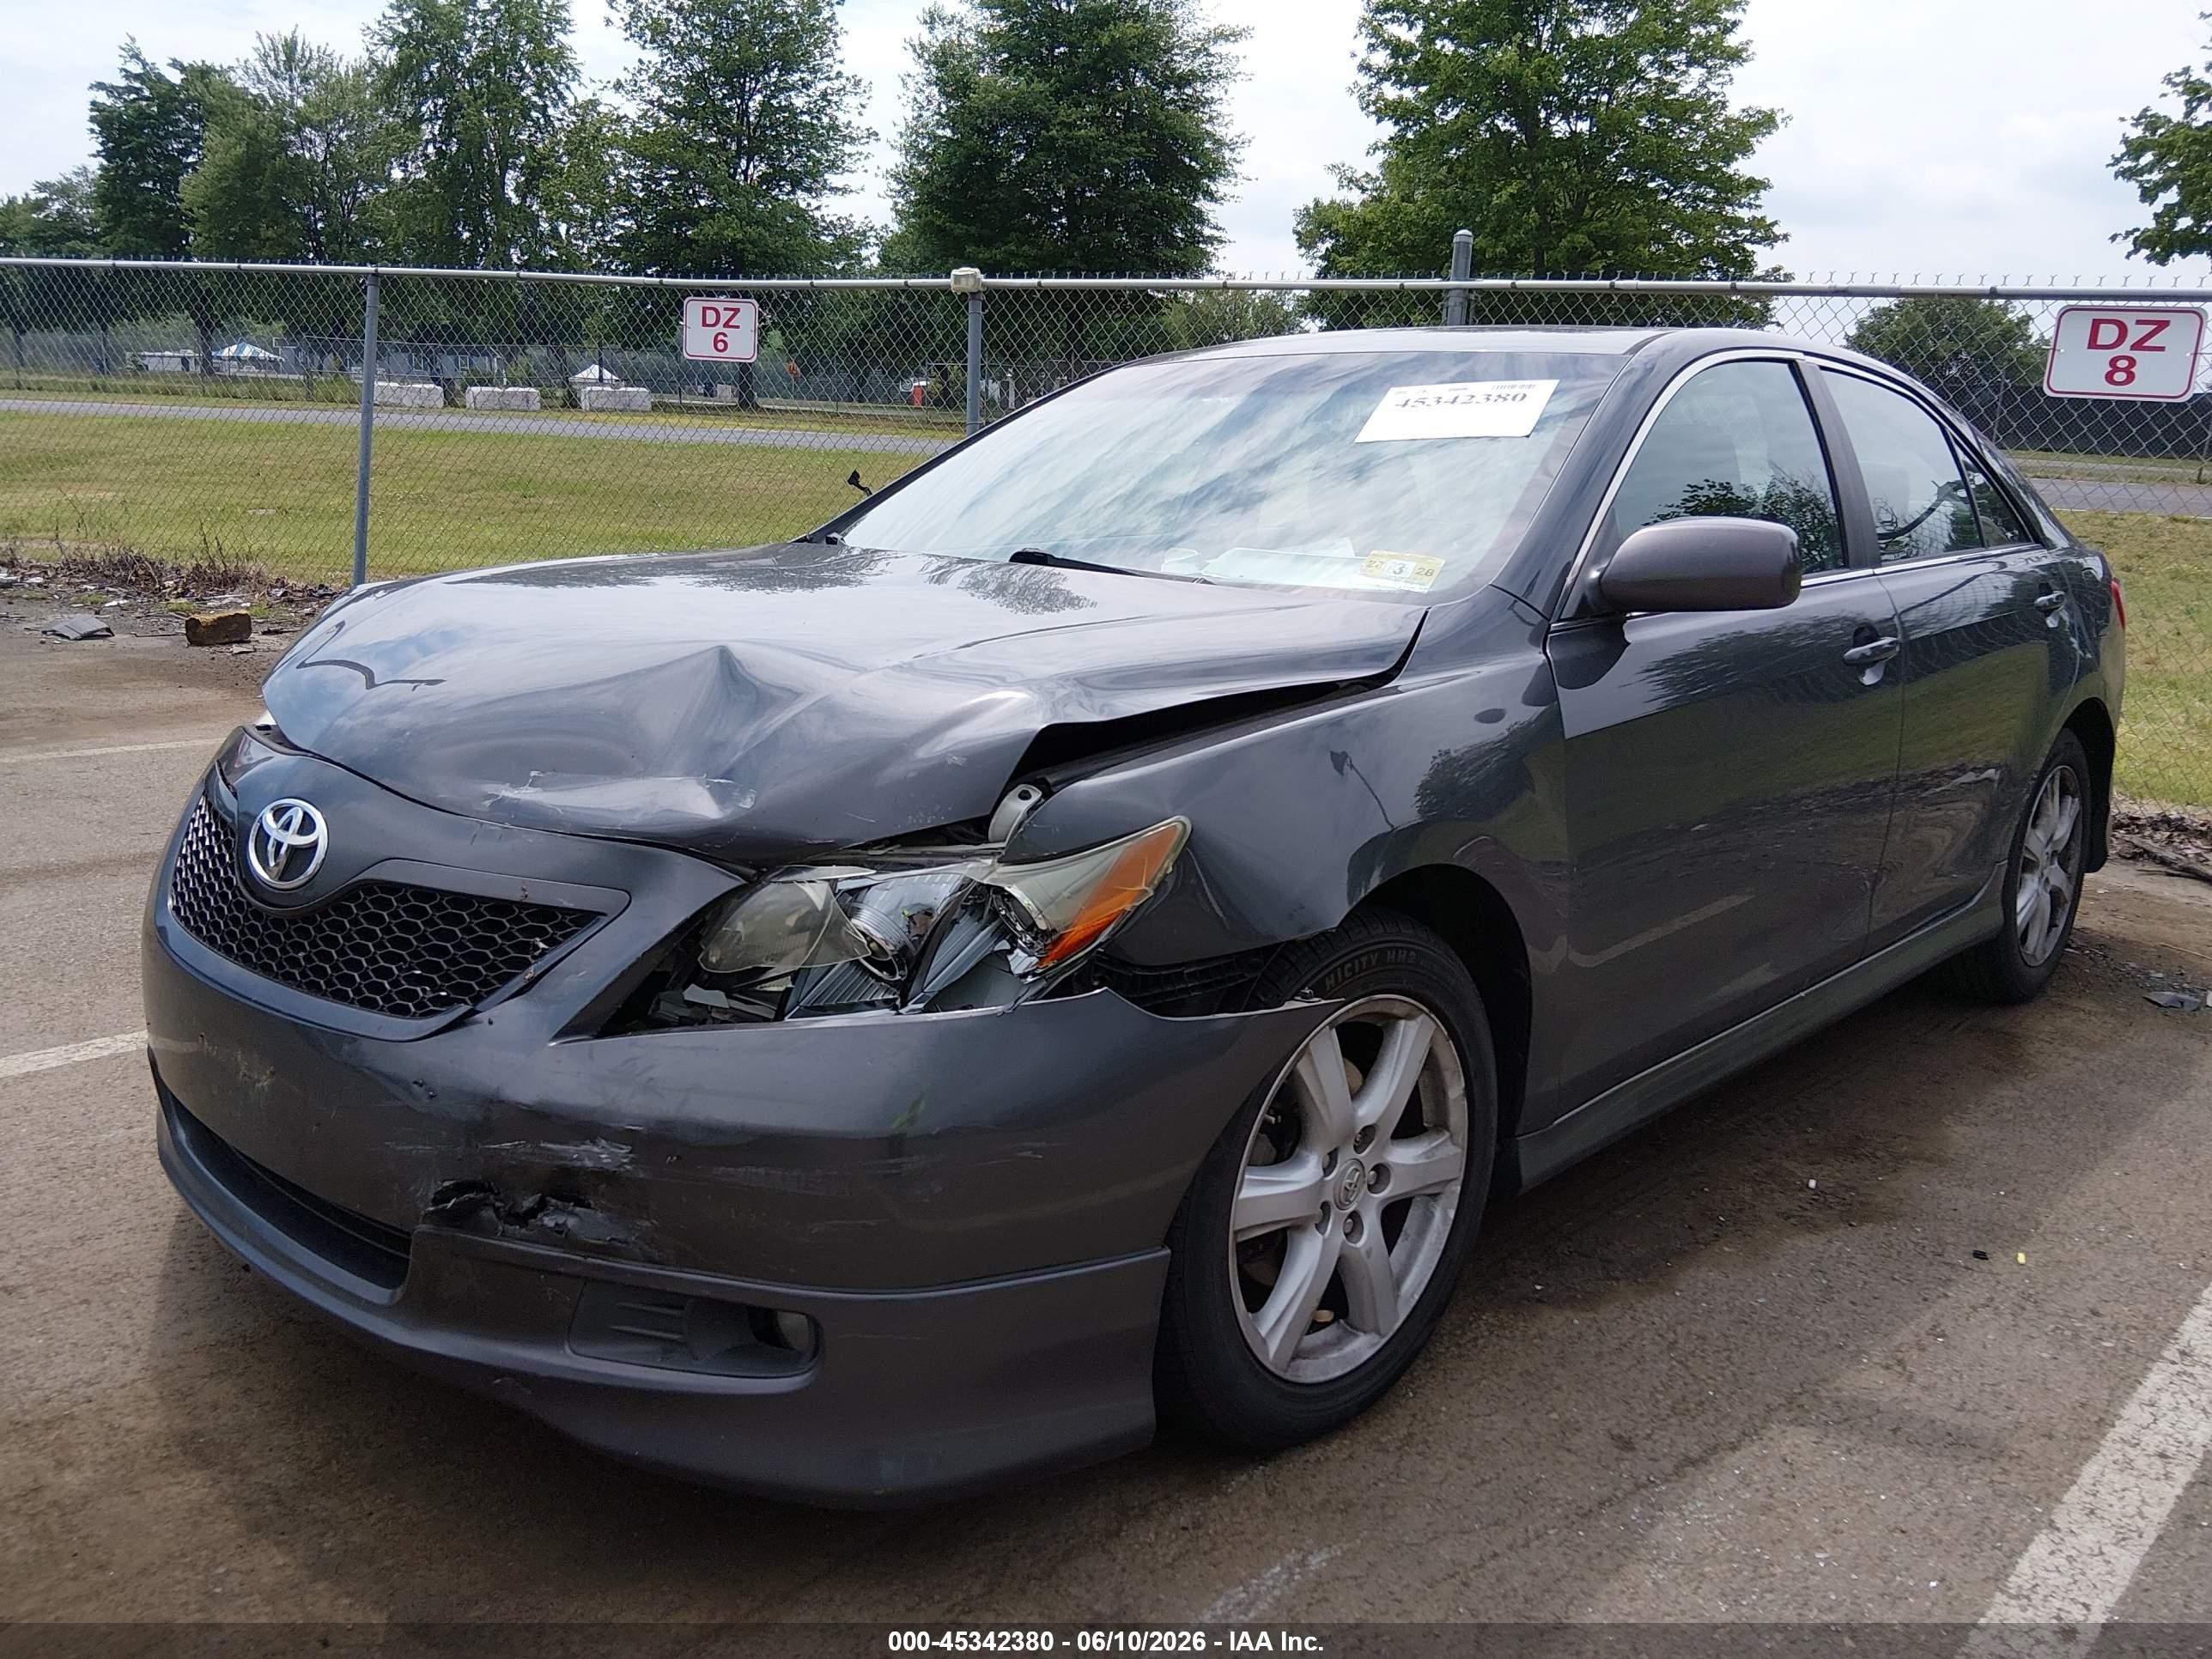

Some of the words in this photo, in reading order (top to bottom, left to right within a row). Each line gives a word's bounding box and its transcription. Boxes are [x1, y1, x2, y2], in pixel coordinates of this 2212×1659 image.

[701, 306, 741, 330] DZ
[713, 331, 729, 353] 6
[2087, 318, 2171, 352] DZ
[2104, 355, 2136, 386] 8
[1395, 392, 1528, 409] 45342380
[1415, 567, 1435, 577] 28
